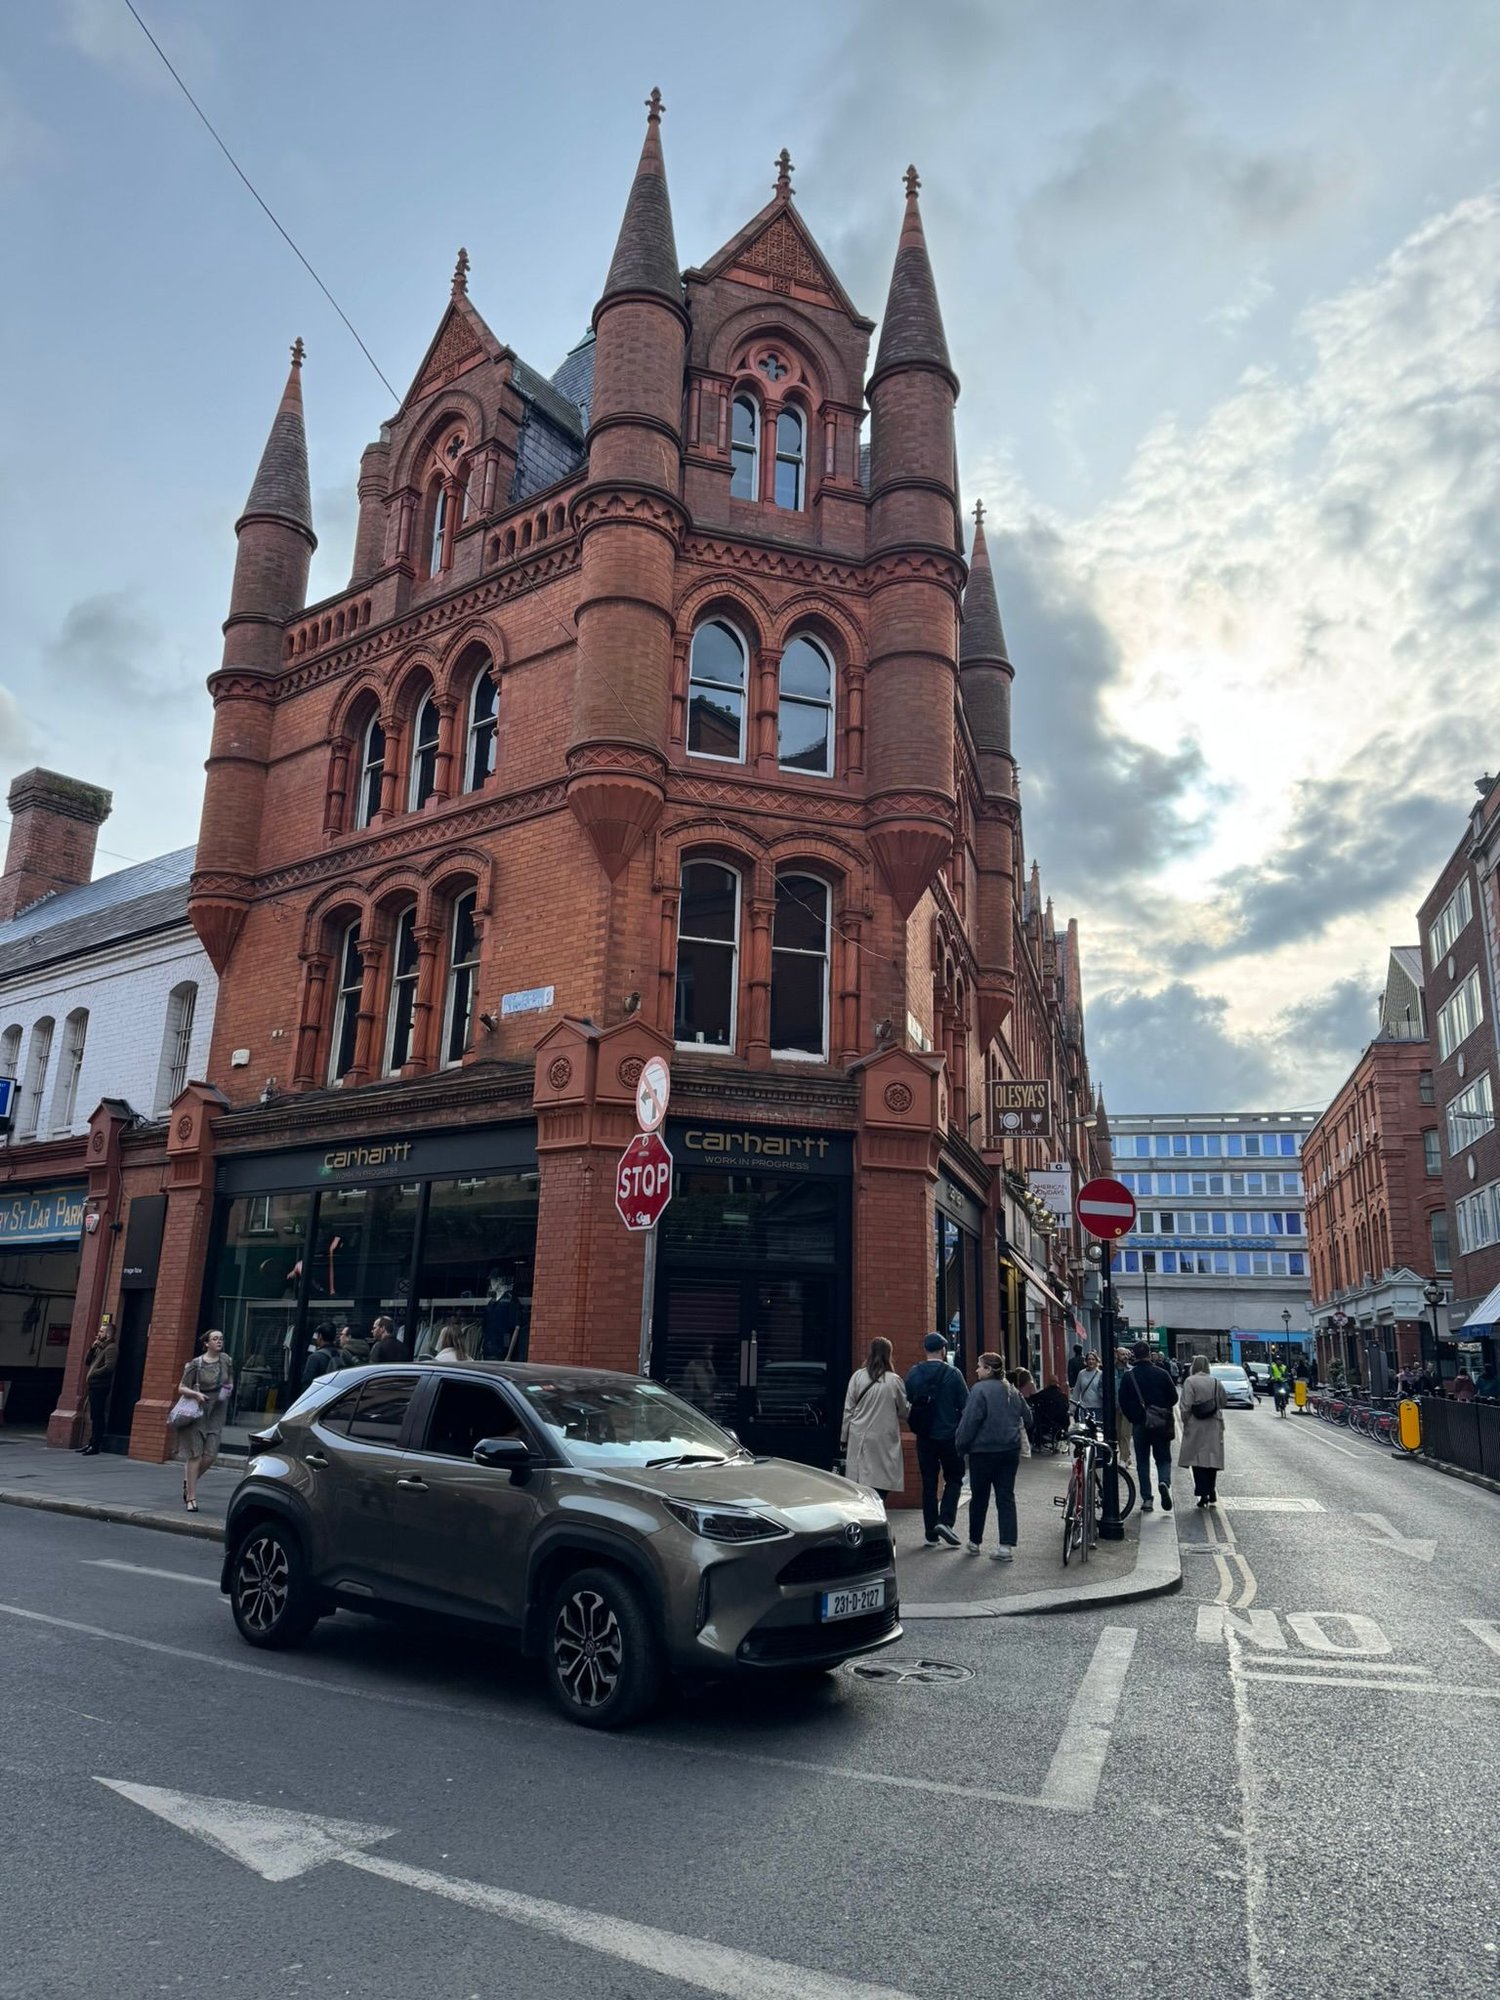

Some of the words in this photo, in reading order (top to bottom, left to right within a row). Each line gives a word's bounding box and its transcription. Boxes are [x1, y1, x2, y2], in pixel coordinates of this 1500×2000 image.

[995, 1085, 1046, 1108] OLESYA'S
[324, 1142, 412, 1169] carhartt
[684, 1130, 830, 1158] carhartt
[704, 1156, 737, 1165] WORK
[752, 1159, 810, 1170] PROGRESS
[619, 1163, 669, 1198] STOP
[834, 1589, 879, 1615] 231-D-2127
[1196, 1604, 1394, 1655] NO
